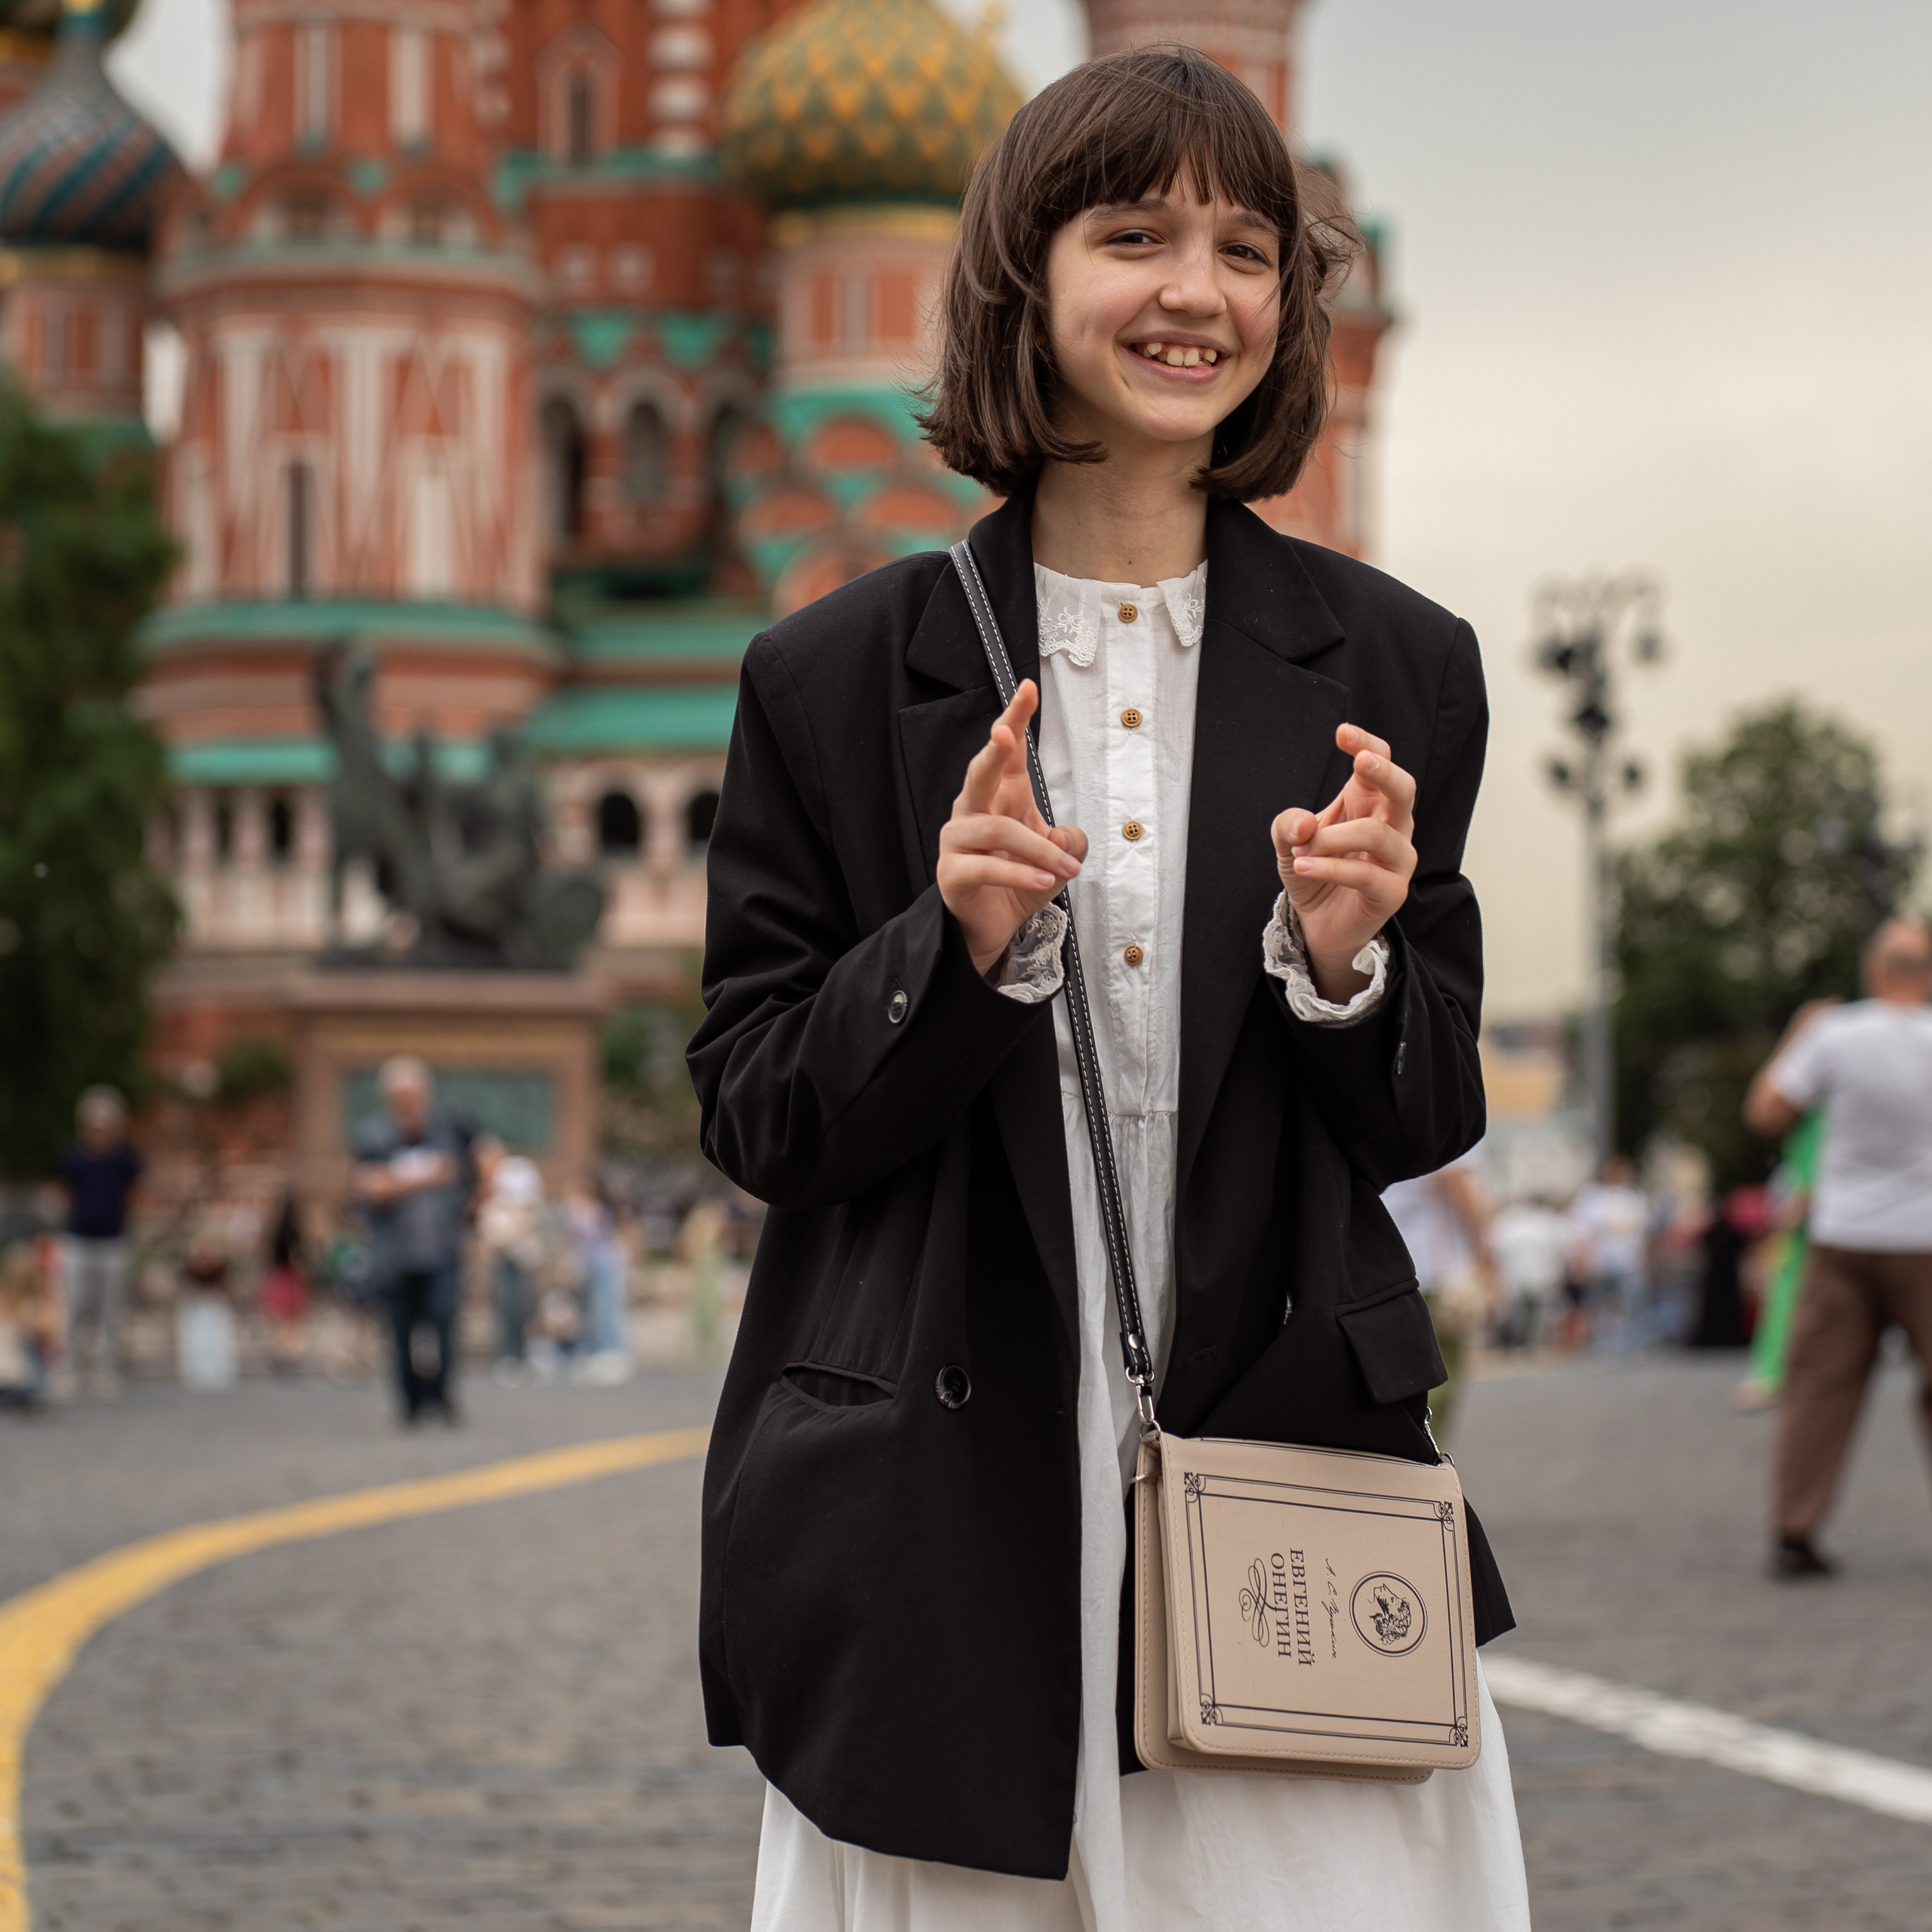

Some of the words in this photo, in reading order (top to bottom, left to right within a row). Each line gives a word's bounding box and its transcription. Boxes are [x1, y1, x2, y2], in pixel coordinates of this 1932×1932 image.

[1270, 1552, 1292, 1658] ОНЕГИН
[1290, 1548, 1315, 1667] ЕВГЕНИЙ
[1321, 1598, 1340, 1660] Пушкин
